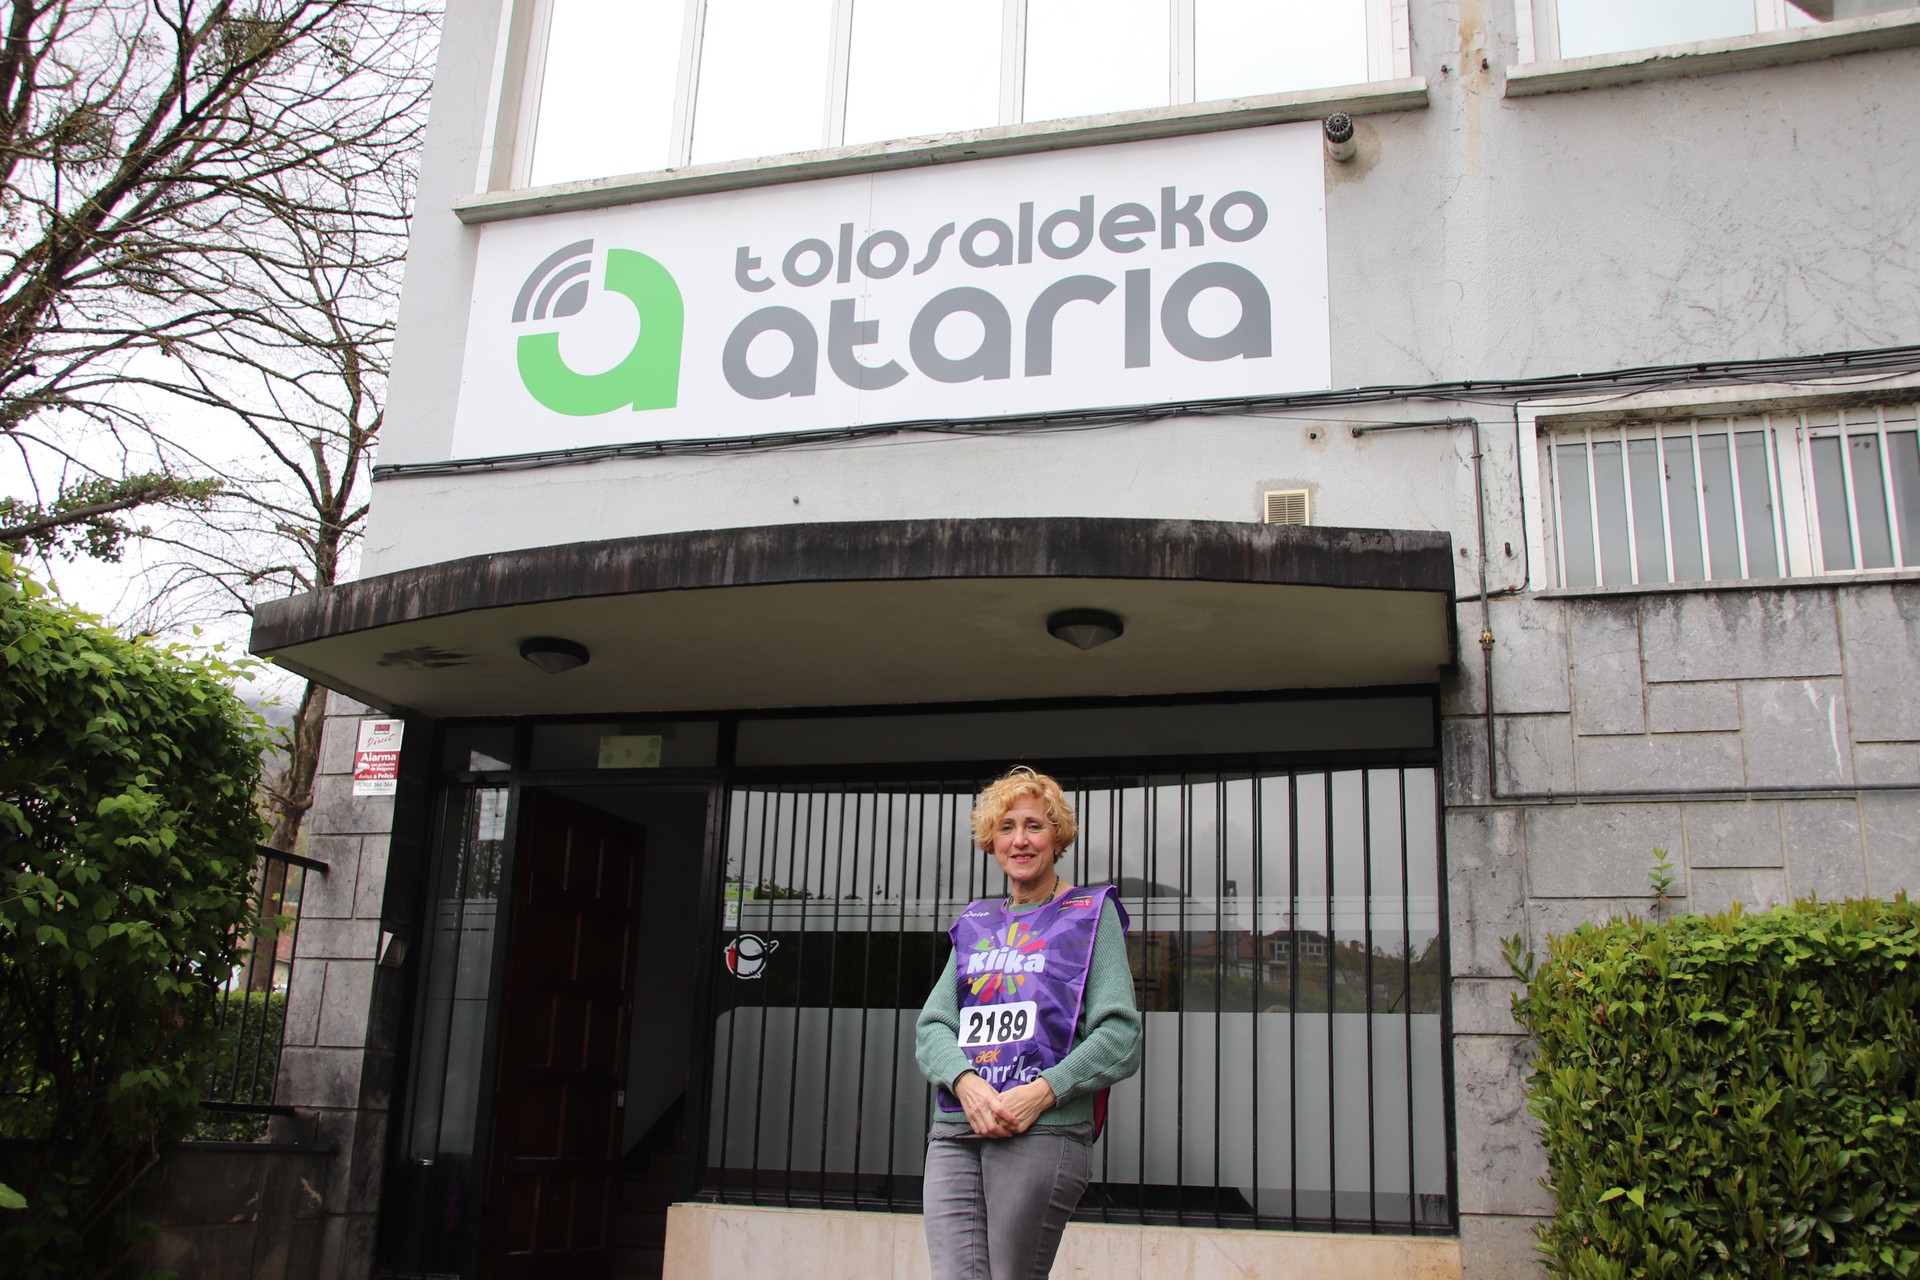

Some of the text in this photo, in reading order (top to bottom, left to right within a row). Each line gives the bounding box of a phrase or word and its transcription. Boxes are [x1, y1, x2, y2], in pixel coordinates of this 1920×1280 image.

[736, 186, 1269, 293] tolosaldeko
[722, 262, 1273, 400] ataria
[360, 752, 396, 761] Alarma
[966, 946, 1046, 974] Klika
[966, 1009, 1028, 1044] 2189
[975, 1045, 1002, 1064] aek
